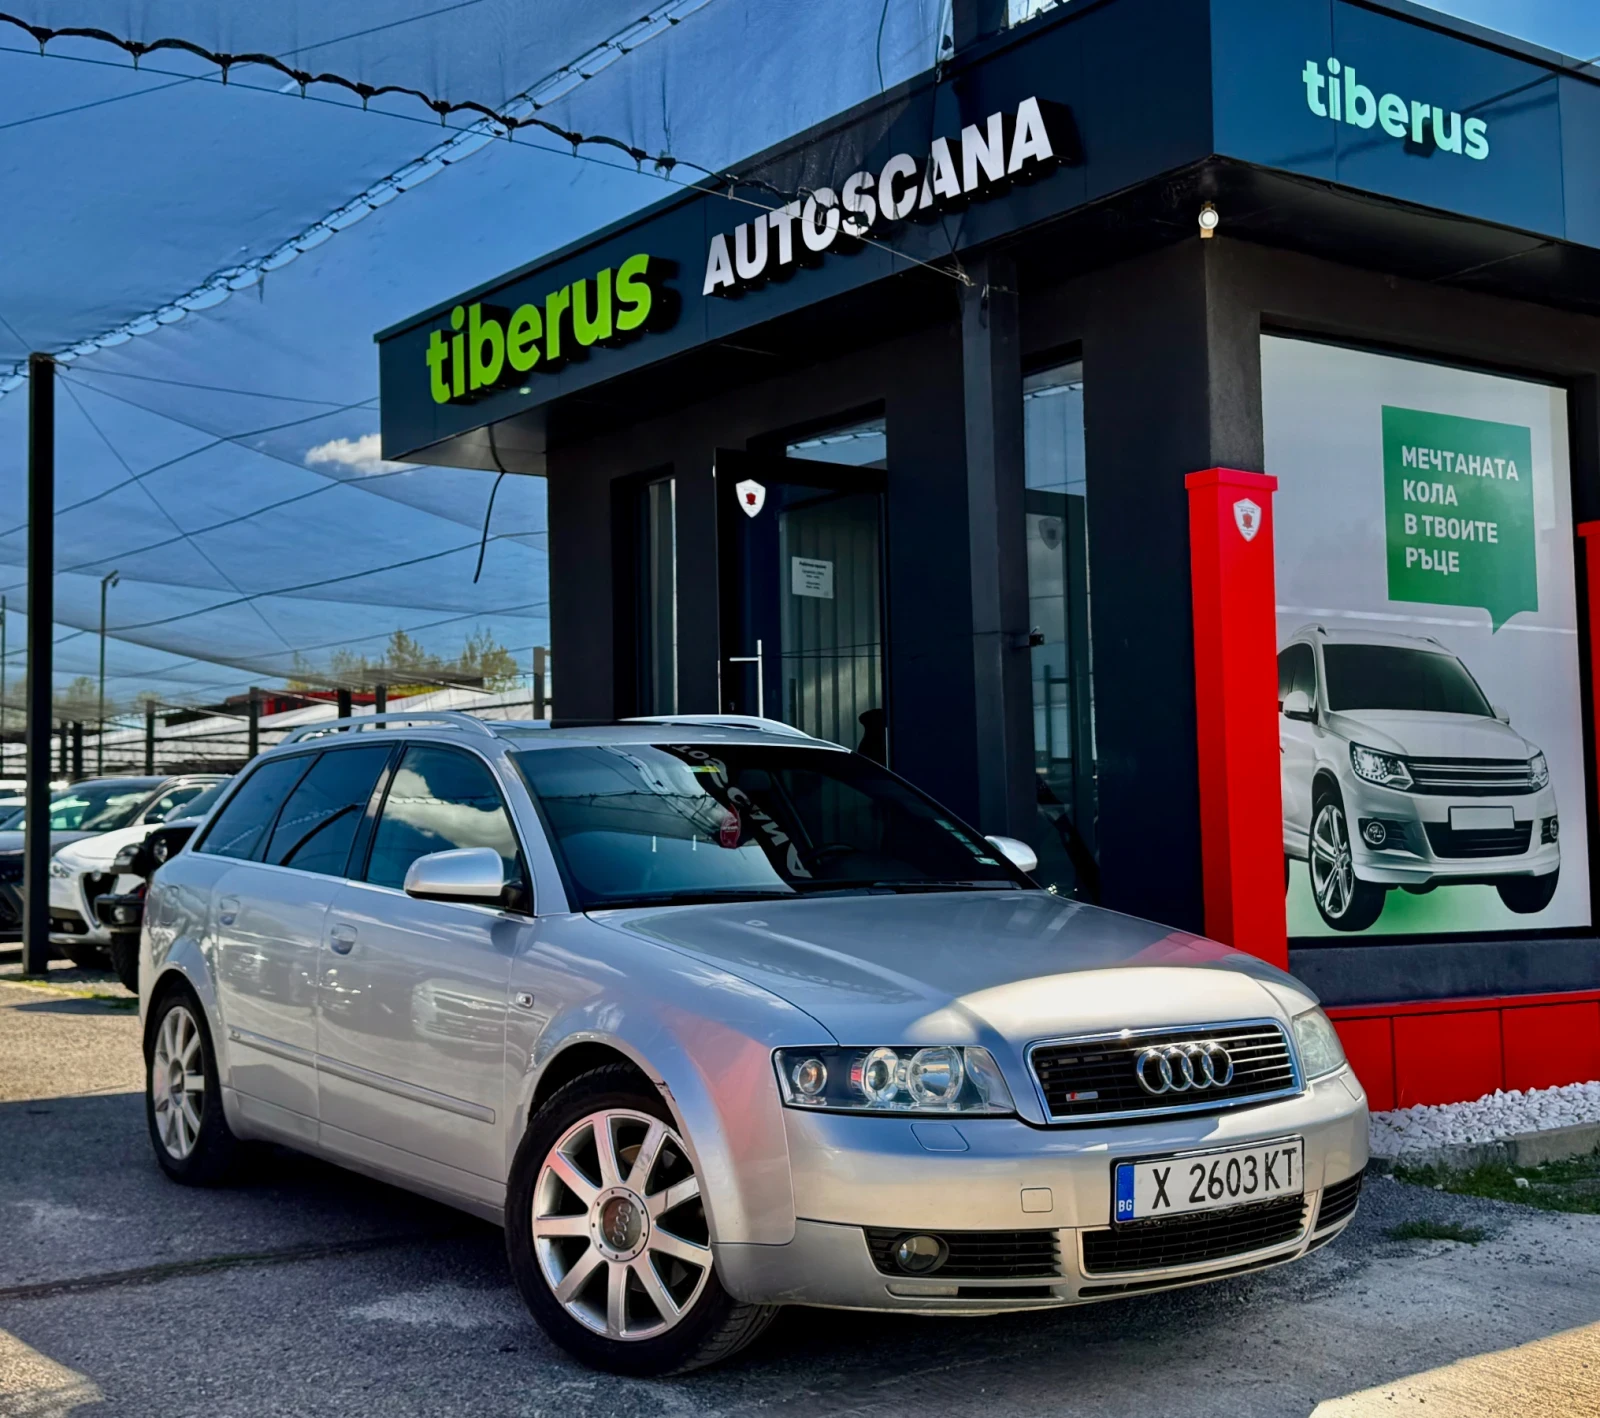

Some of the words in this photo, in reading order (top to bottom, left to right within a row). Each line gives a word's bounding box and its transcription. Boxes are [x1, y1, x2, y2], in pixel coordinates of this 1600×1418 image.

[1302, 57, 1490, 160] tiberus
[426, 254, 652, 403] tiberus
[702, 96, 1054, 295] AUTOSCANA
[1401, 445, 1519, 481] МЕЧТАНАТА
[1403, 479, 1458, 506] КОЛА
[1404, 513, 1418, 535] В
[1421, 515, 1498, 543] ТВОИТЕ
[1405, 547, 1460, 575] РЪЦЕ
[1118, 1200, 1132, 1212] BG
